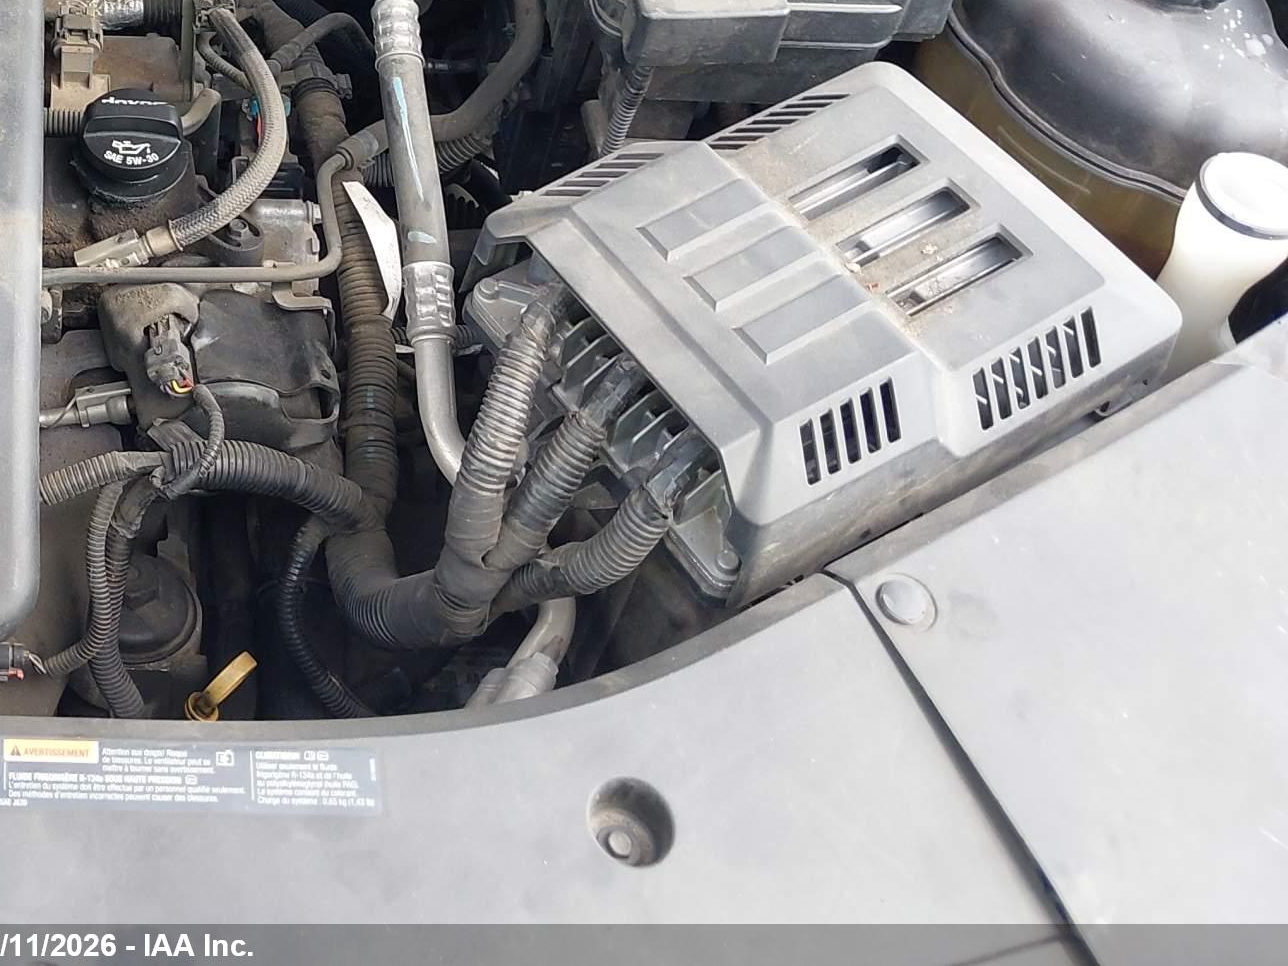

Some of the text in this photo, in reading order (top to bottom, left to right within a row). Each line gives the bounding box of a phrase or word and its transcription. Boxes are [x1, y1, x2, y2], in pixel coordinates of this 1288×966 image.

[104, 150, 159, 165] SAE 5W-30
[23, 747, 89, 758] AVERTISSEMENT
